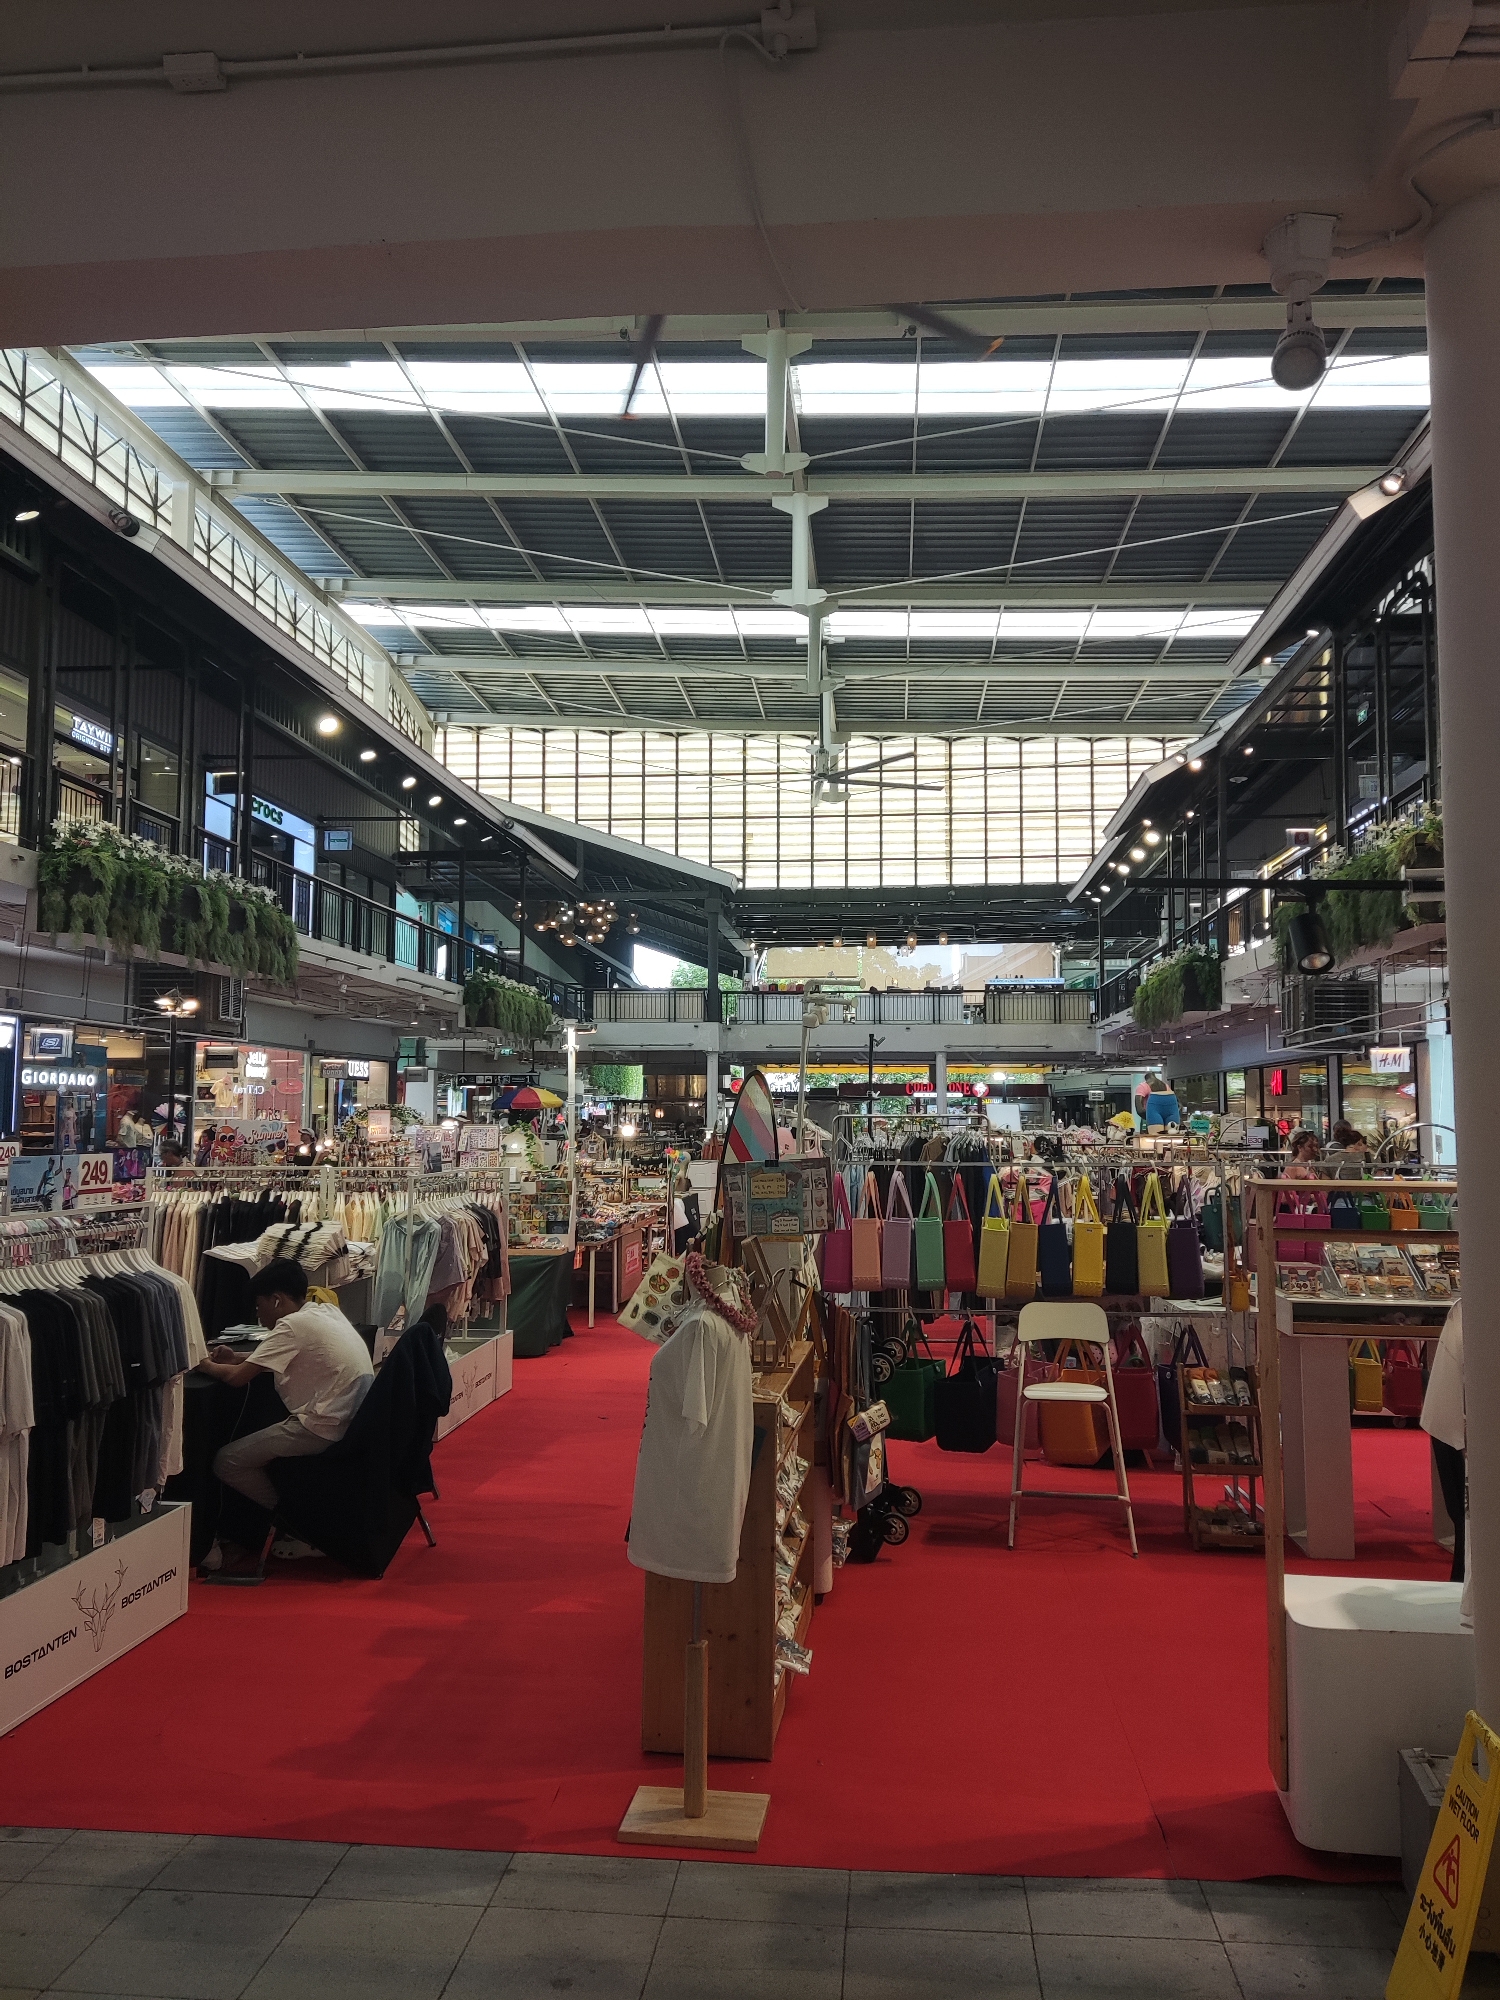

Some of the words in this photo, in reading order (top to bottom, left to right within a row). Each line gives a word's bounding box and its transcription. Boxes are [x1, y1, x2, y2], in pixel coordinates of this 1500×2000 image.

[100, 743, 111, 753] STY
[252, 798, 284, 825] crocs
[348, 1060, 369, 1077] UESS
[1379, 1053, 1402, 1067] H&M
[21, 1069, 96, 1087] GIORDANO
[905, 1082, 934, 1095] COLD
[81, 1160, 108, 1186] 249
[4, 1626, 78, 1679] BOSTANTEN
[121, 1567, 177, 1609] BOSTANTEN
[1455, 1784, 1480, 1822] CAUTION
[1448, 1794, 1463, 1818] WET
[1460, 1808, 1480, 1844] FLOOR
